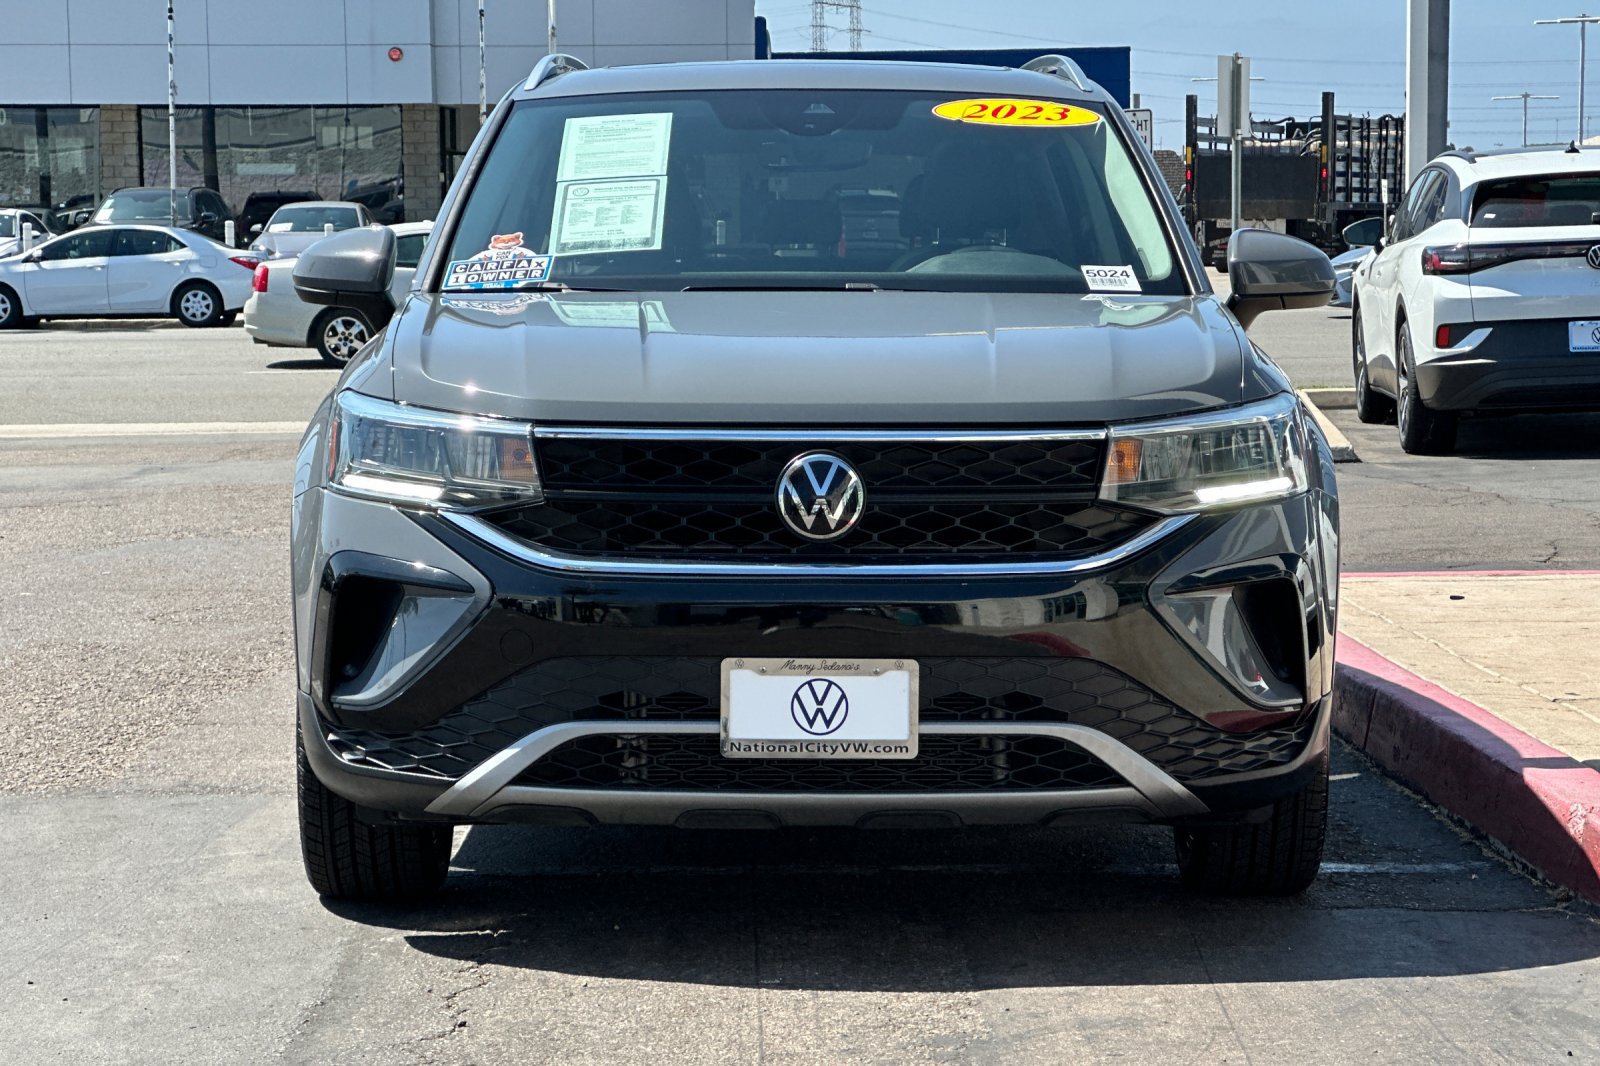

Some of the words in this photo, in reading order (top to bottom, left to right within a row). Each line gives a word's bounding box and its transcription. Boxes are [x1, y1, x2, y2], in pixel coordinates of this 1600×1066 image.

[963, 103, 1071, 121] 2023
[455, 260, 545, 273] CARFAX
[466, 269, 543, 283] OWNER
[1085, 269, 1131, 279] 5024
[780, 659, 815, 675] Manny
[730, 741, 909, 755] NationalCityVW.com
